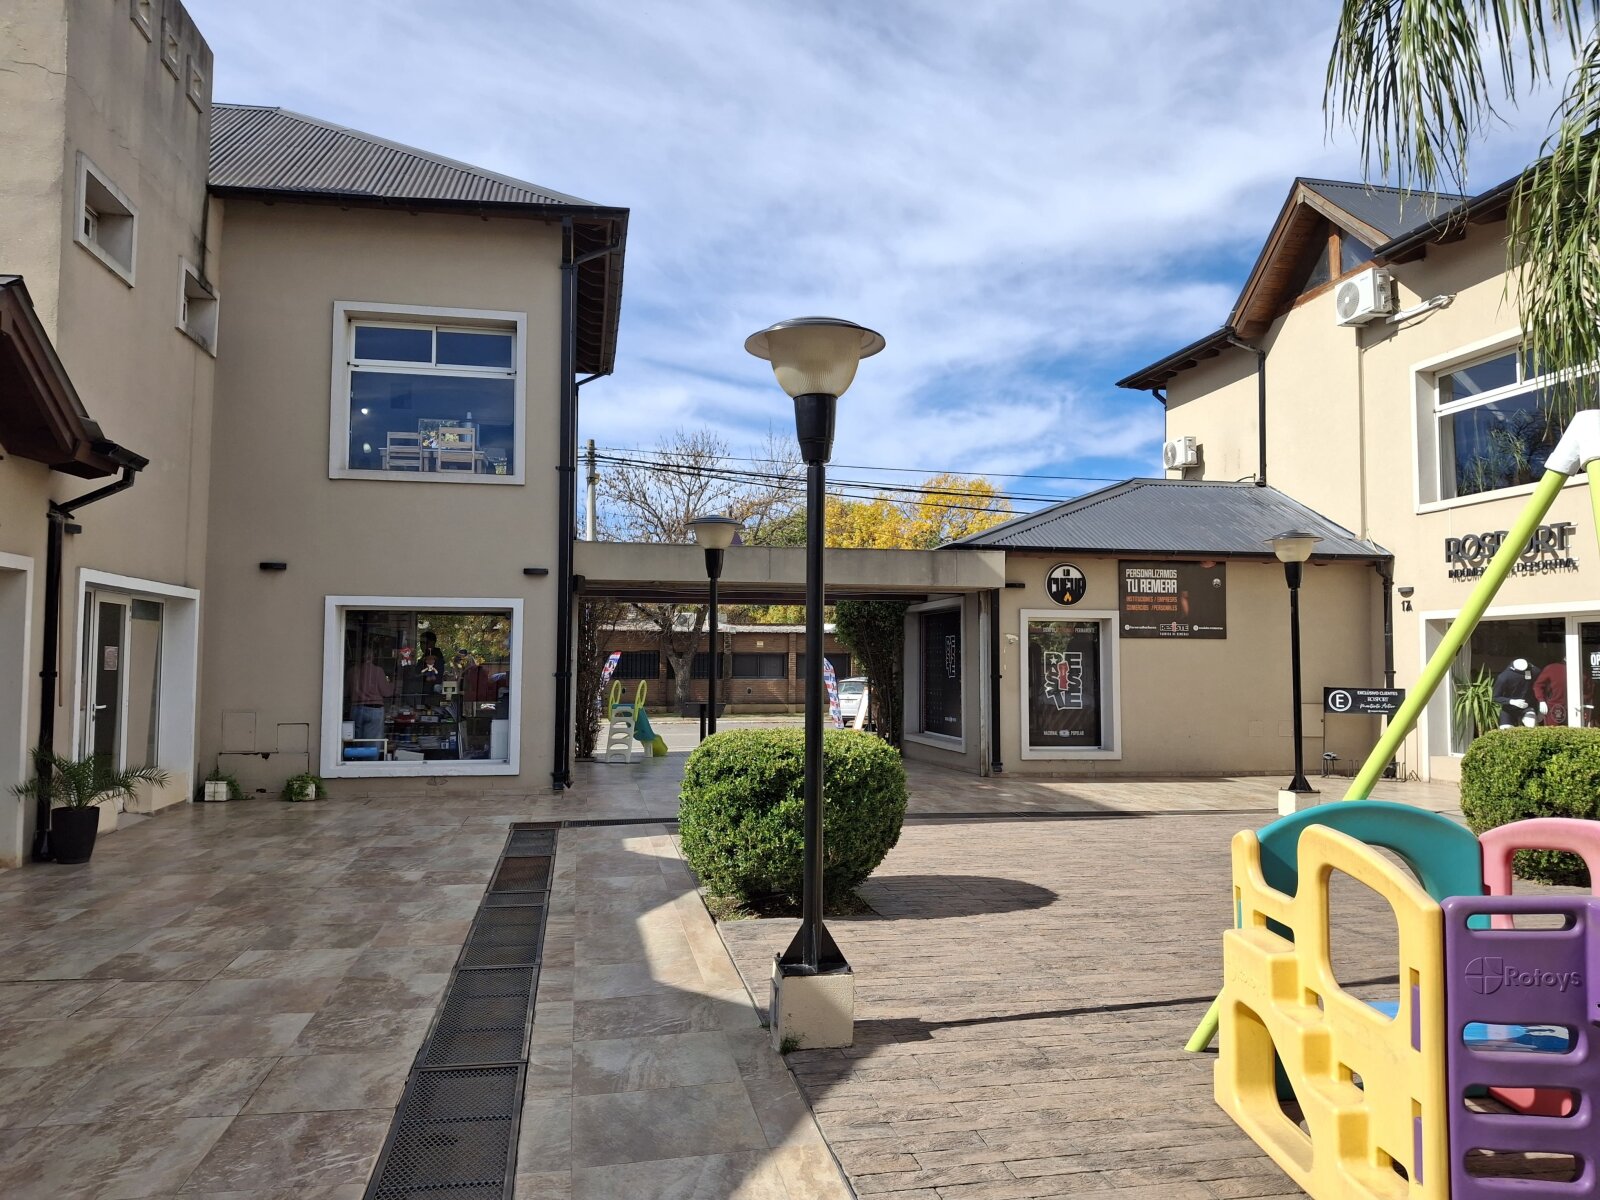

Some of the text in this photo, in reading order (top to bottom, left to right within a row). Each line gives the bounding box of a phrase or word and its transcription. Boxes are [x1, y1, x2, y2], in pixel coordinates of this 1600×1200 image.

[1517, 558, 1573, 572] DEPORTIVA
[1126, 568, 1177, 578] PERSONALIZAMOS
[1126, 579, 1177, 593] TU REMERA
[1160, 622, 1189, 632] RESISTE
[1336, 694, 1344, 708] E
[1504, 966, 1581, 992] Rotoys
